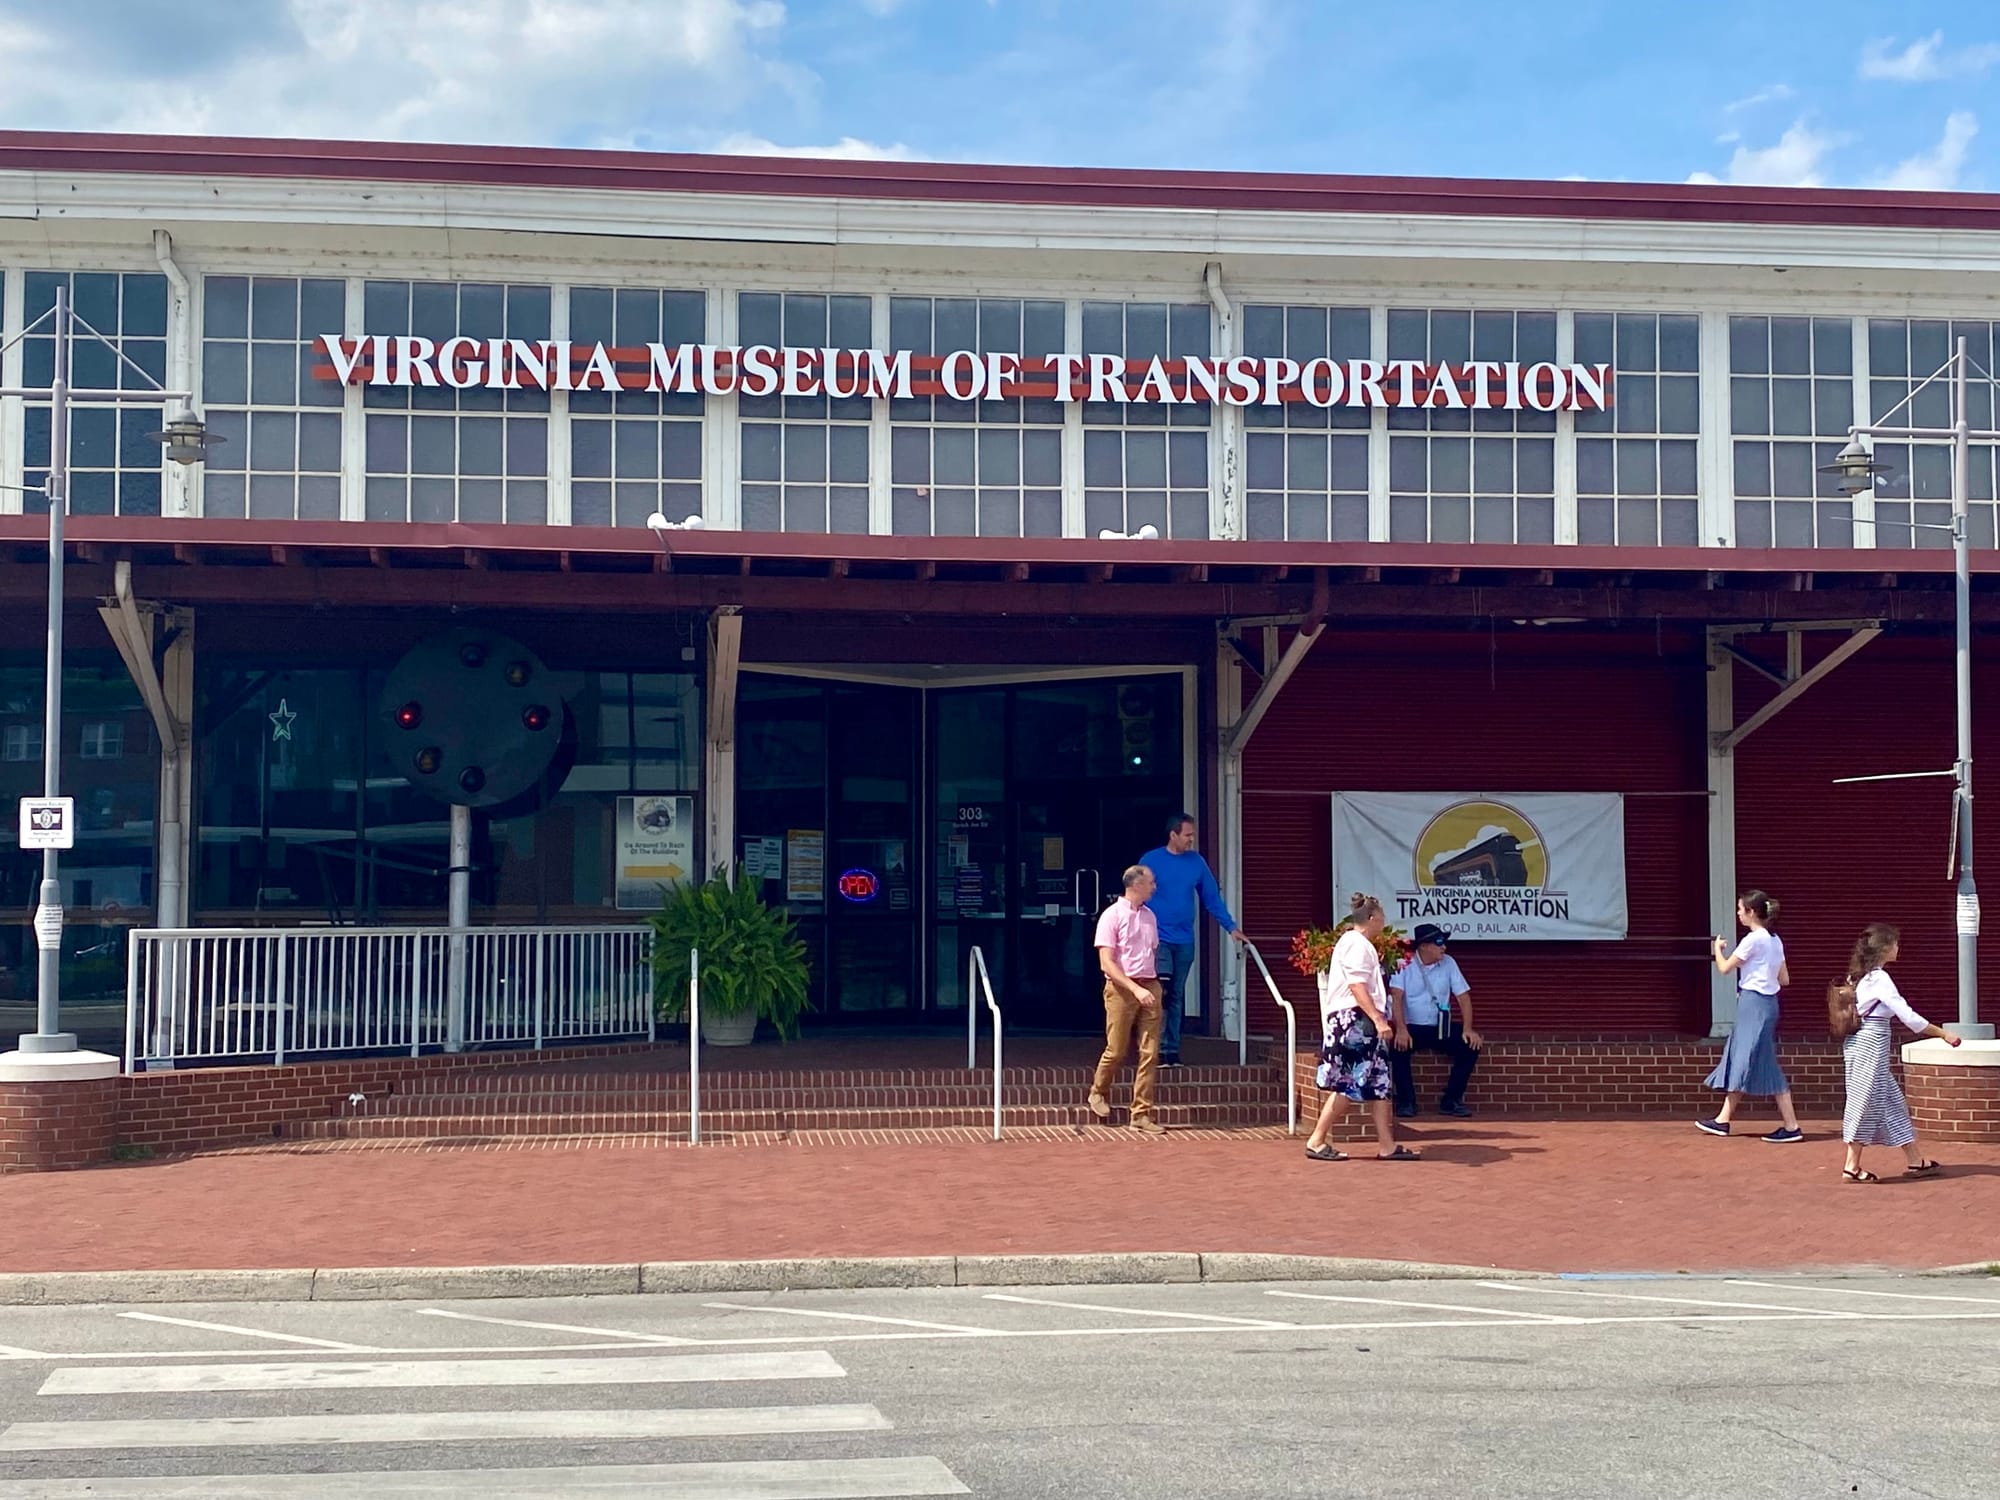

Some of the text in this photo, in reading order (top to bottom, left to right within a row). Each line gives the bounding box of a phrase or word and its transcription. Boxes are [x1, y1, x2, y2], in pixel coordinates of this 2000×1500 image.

[320, 334, 1610, 412] VIRGINIA MUSEUM OF TRANSPORTATION
[959, 807, 983, 820] 303
[839, 876, 875, 895] OPEN
[1422, 888, 1541, 898] VIRGINIA MUSEUM OF
[1397, 898, 1569, 920] TRANSPORTATION
[1508, 923, 1528, 933] AIR
